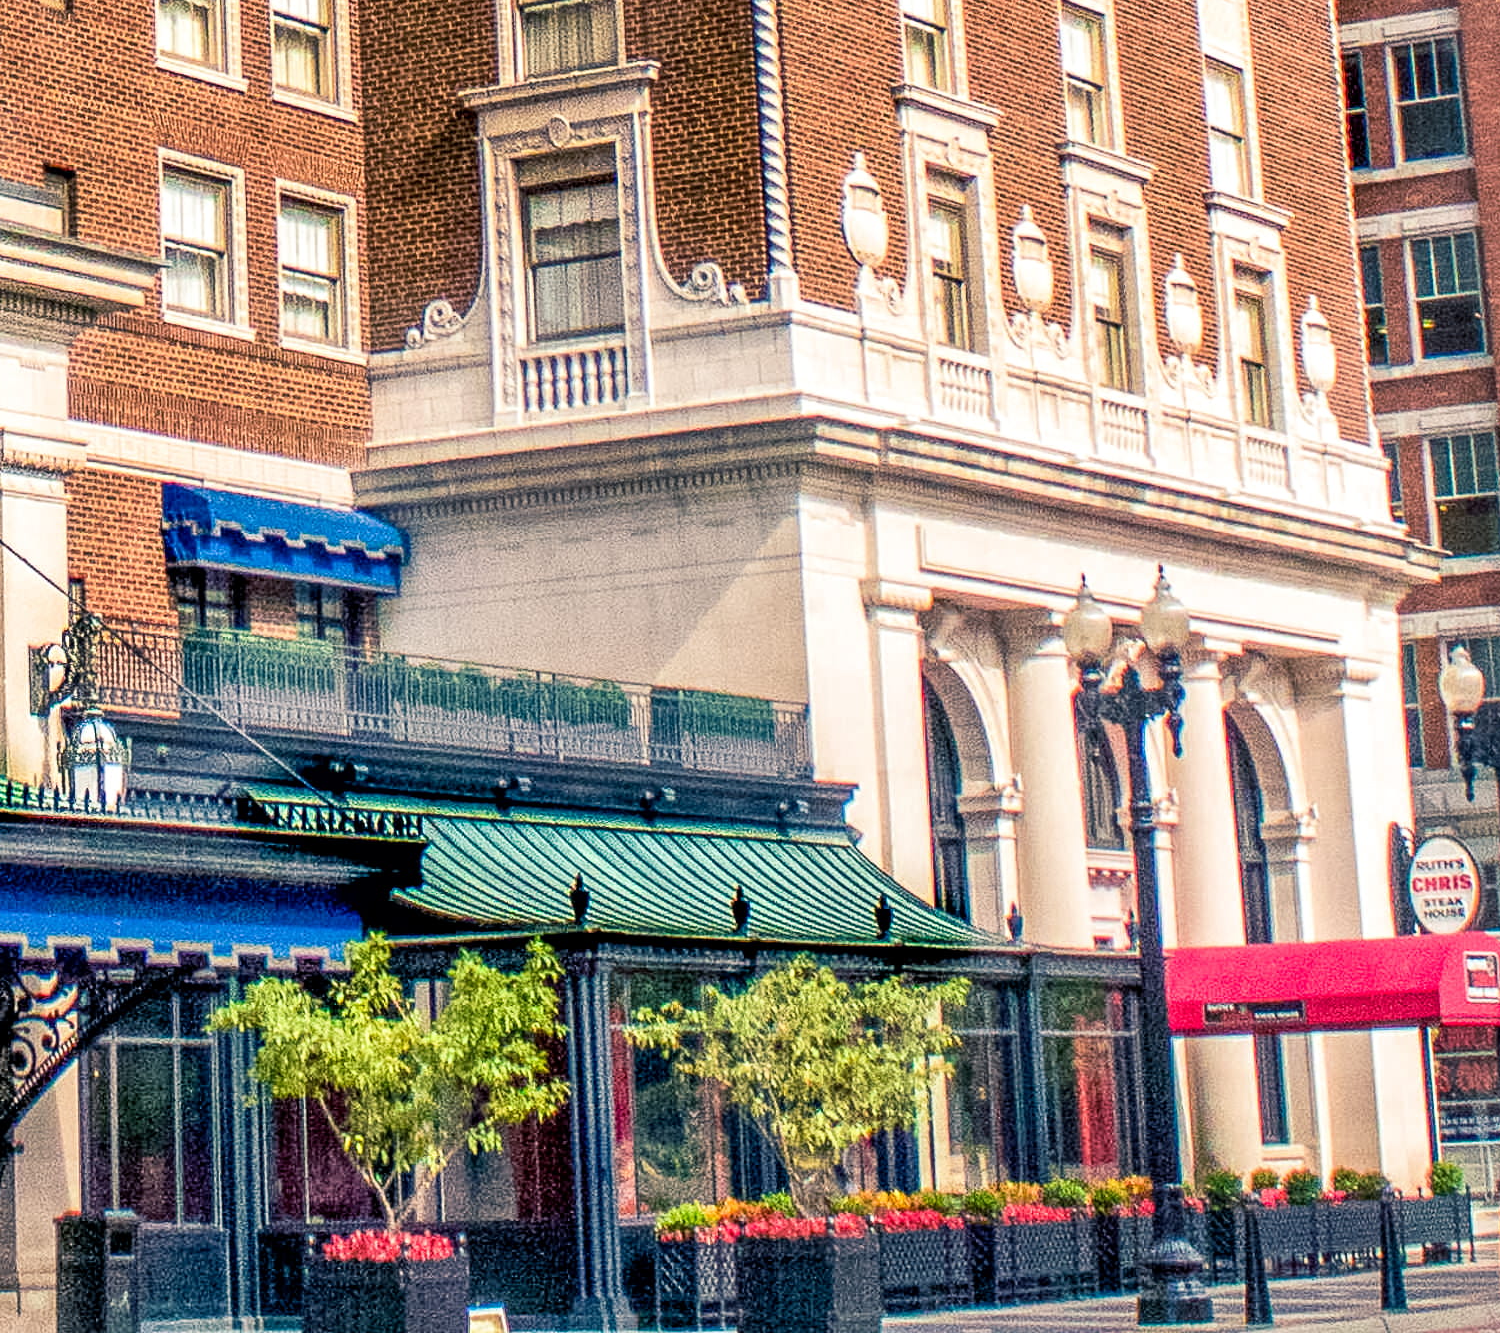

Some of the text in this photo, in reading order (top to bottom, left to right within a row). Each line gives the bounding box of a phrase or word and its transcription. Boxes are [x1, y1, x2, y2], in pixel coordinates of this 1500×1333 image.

[1415, 857, 1465, 870] RUTH'S
[1412, 874, 1472, 892] CHRIS
[1423, 897, 1463, 907] STEAK
[1423, 907, 1465, 918] HOUSE
